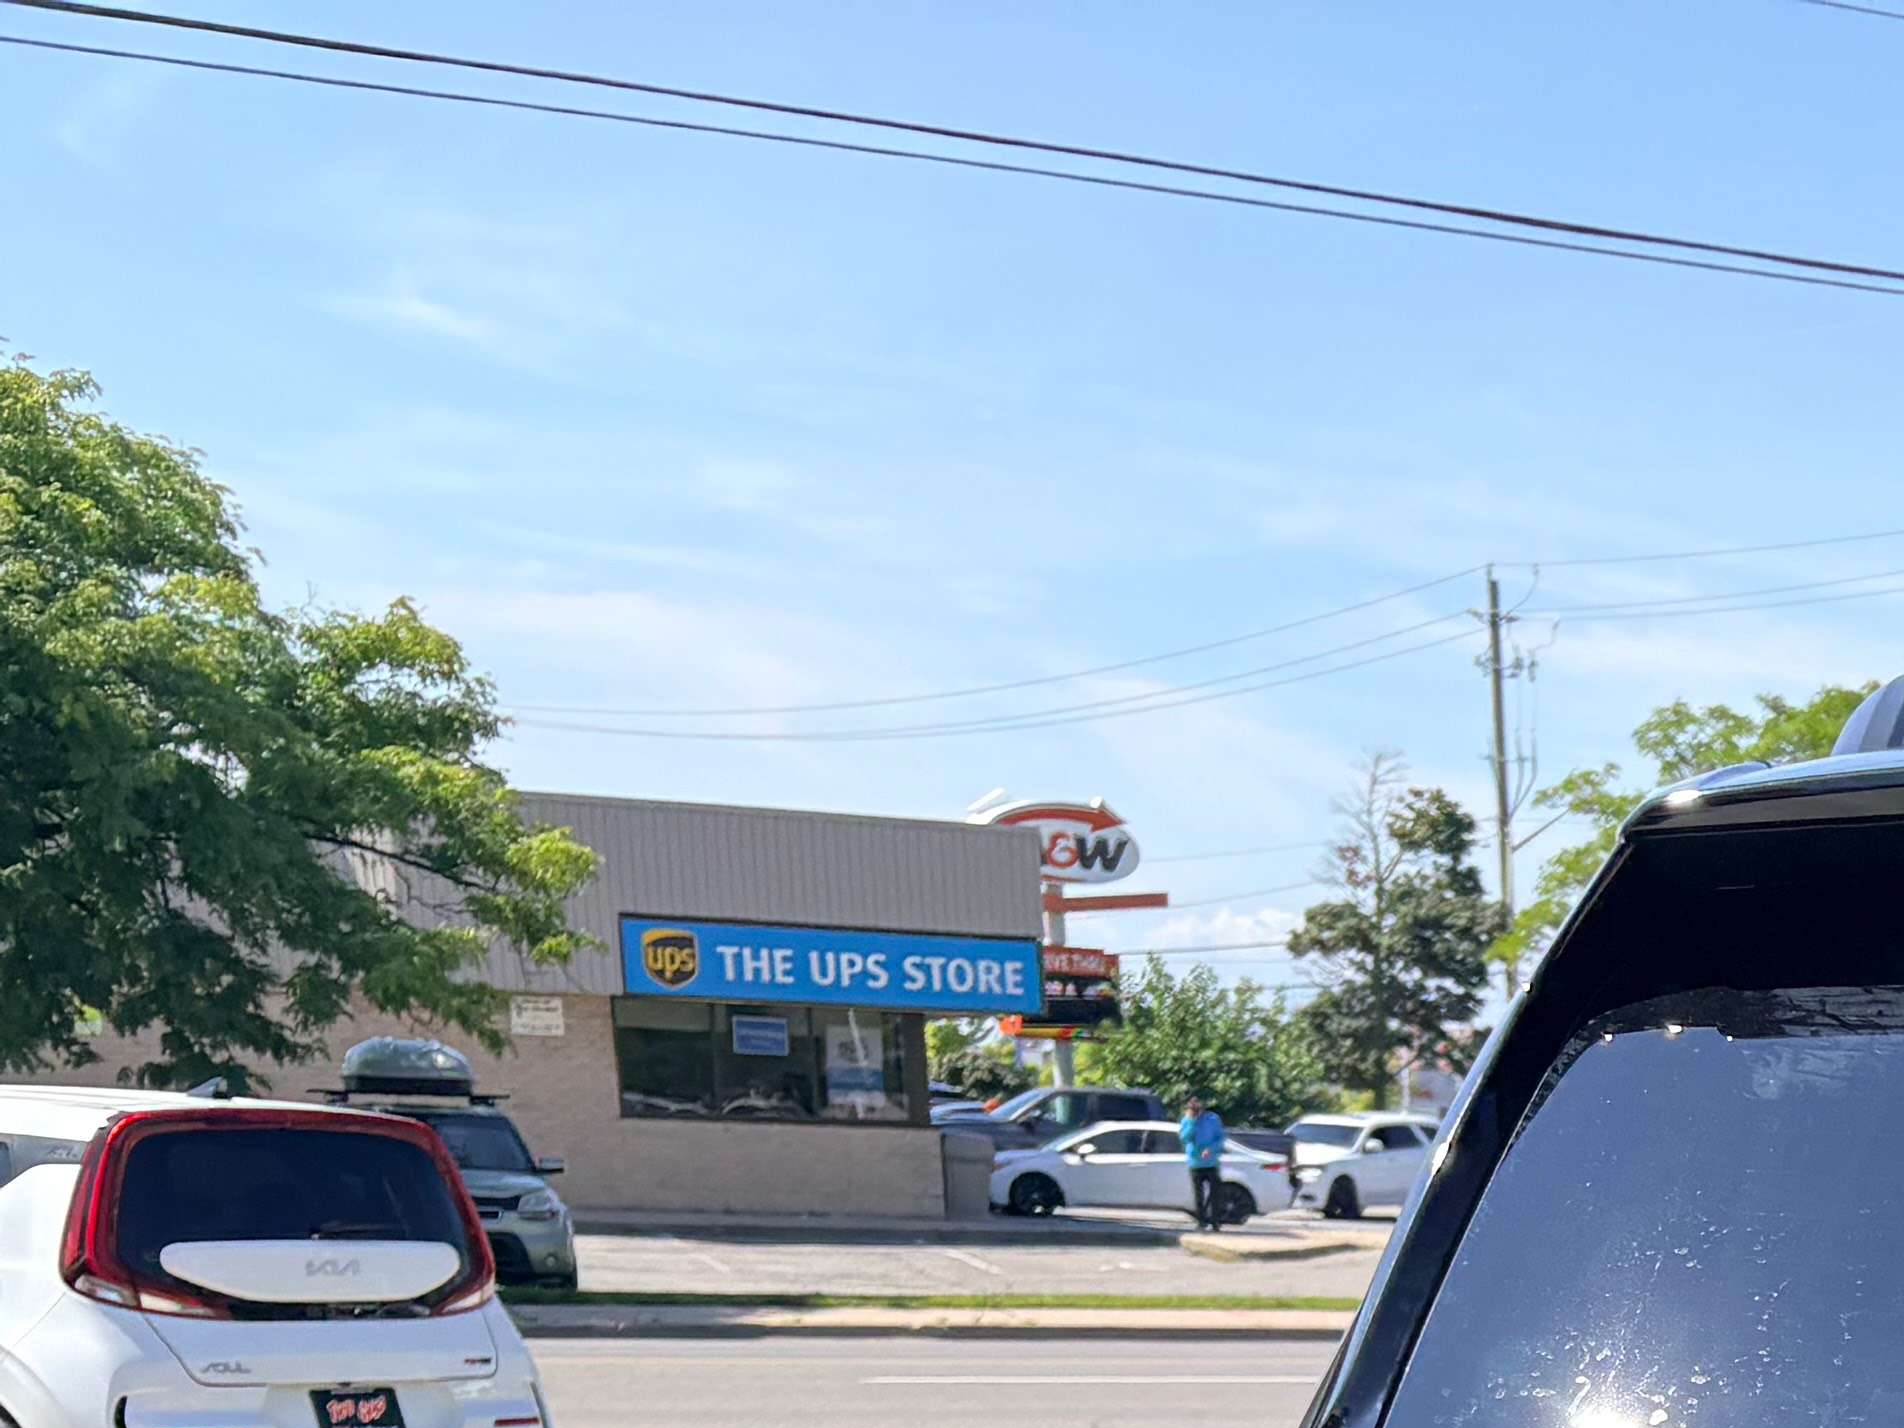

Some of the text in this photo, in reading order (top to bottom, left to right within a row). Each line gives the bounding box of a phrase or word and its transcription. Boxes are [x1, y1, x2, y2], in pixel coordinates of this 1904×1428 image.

[1041, 831, 1130, 873] &W
[648, 947, 696, 981] ups
[717, 946, 795, 985] THE
[809, 952, 889, 989] UPS
[903, 956, 1024, 995] STORE
